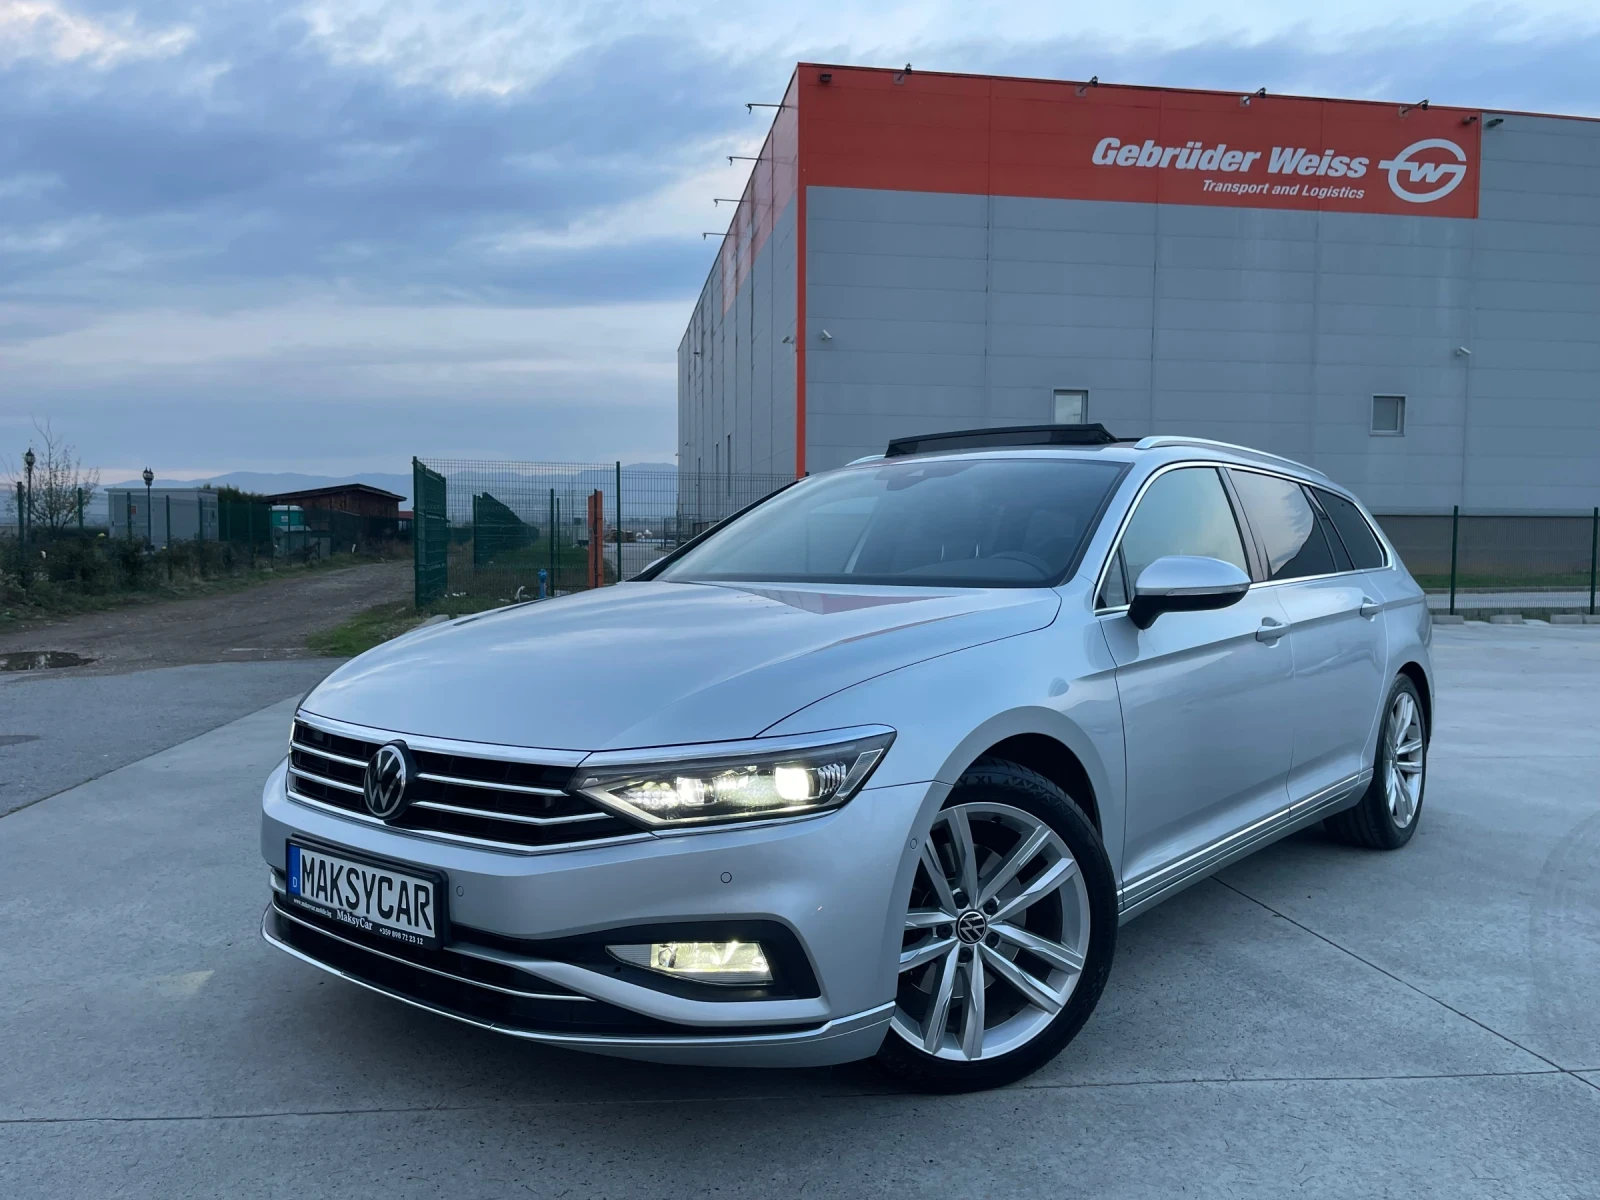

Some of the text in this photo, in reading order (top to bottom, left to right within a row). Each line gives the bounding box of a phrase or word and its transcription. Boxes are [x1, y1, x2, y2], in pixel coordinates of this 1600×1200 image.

[1091, 137, 1370, 179] Gebrüder Weiss
[1203, 179, 1365, 199] Transport and Logistics
[301, 854, 433, 931] MAKSYCAR
[336, 909, 373, 931] MaksyCar
[416, 937, 424, 946] 12
